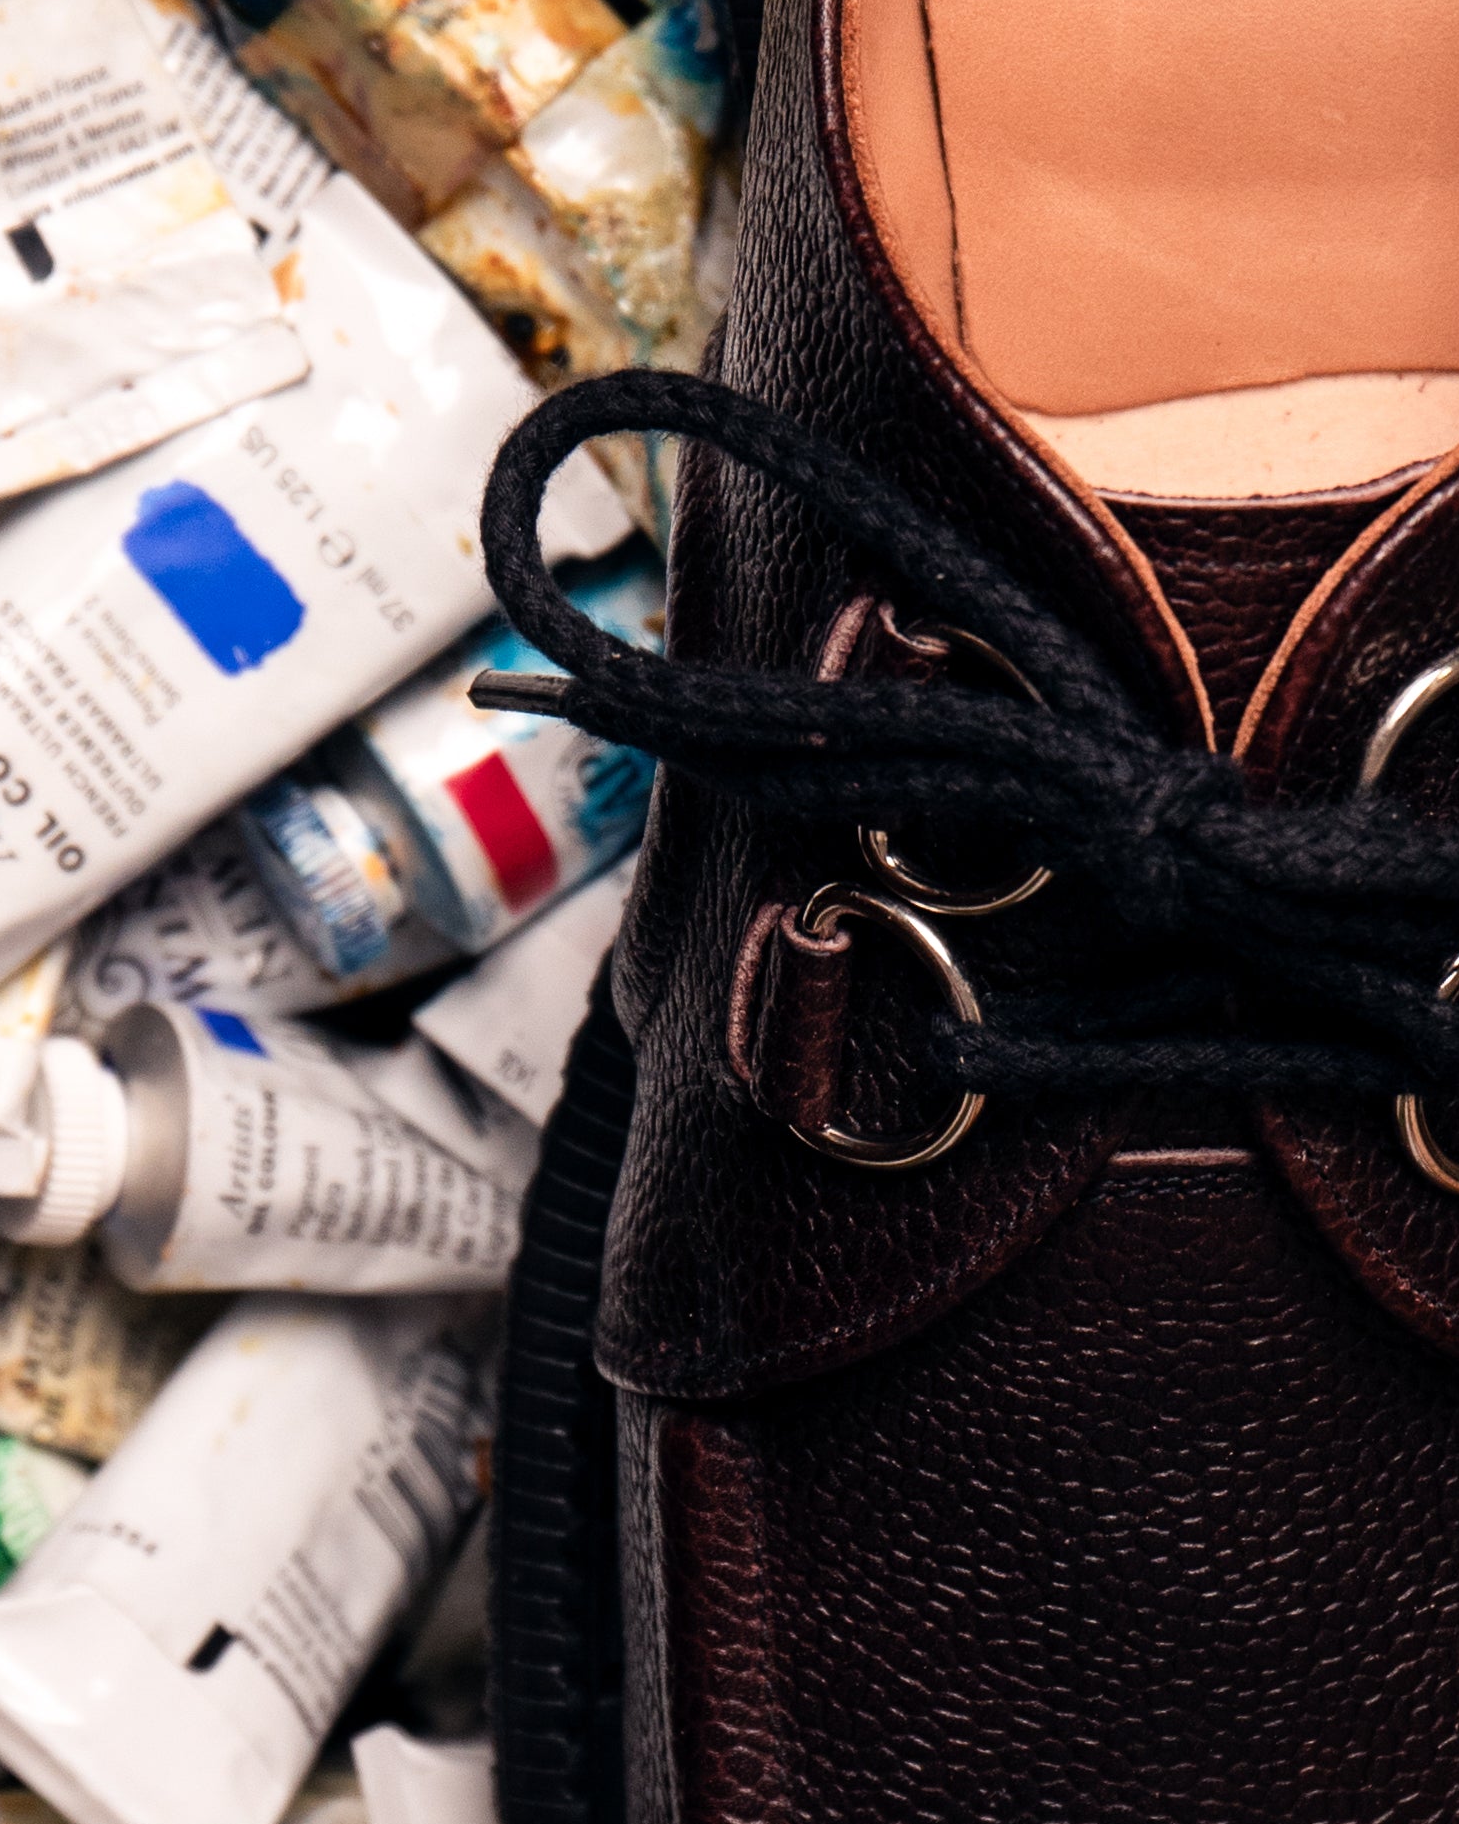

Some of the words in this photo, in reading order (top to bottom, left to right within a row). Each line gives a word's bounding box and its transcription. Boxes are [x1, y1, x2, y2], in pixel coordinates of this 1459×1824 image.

[272, 468, 325, 523] 1.25
[380, 595, 415, 631] 37
[51, 707, 151, 817] OUTREMER
[72, 688, 166, 791] ULTRAMAR
[59, 758, 131, 837] FRENCH
[38, 814, 85, 872] OIL
